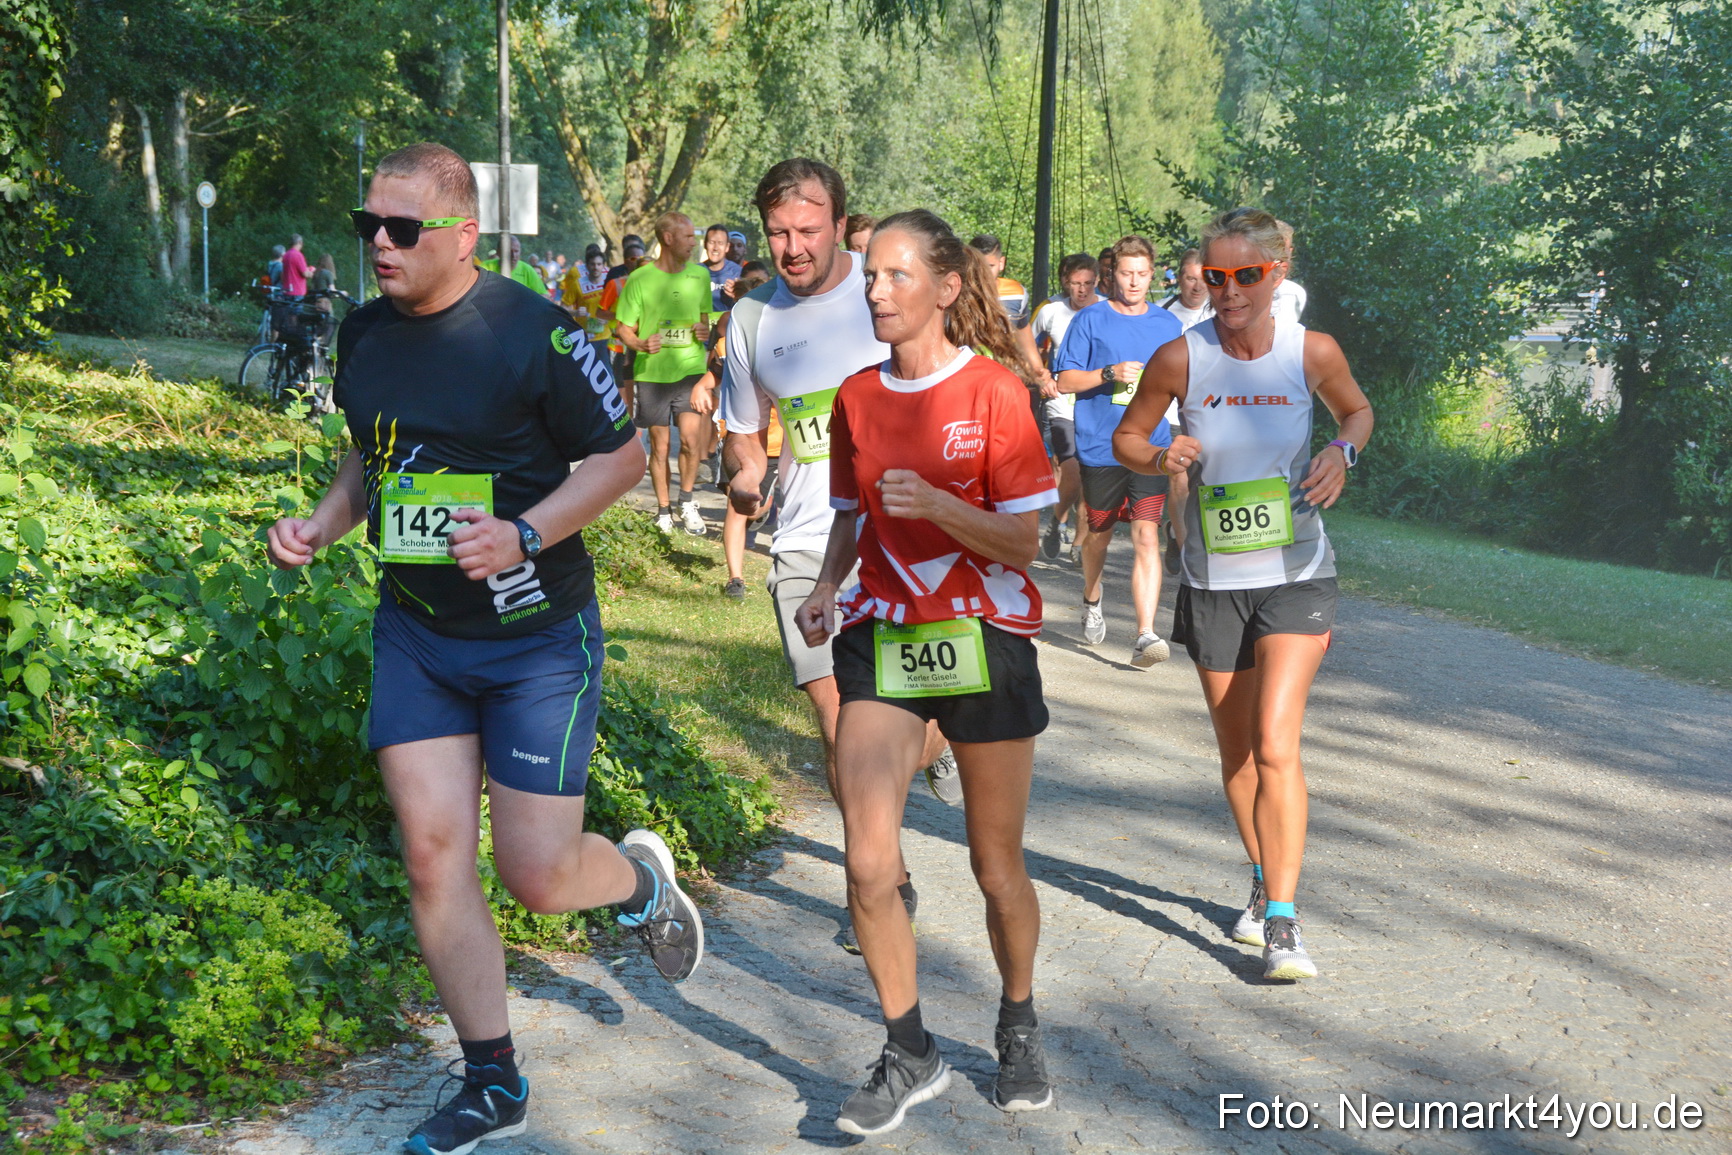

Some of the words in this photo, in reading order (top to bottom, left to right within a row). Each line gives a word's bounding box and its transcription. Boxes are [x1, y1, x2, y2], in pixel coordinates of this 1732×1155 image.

[665, 329, 686, 339] 441
[1125, 382, 1135, 395] 6
[1226, 395, 1294, 406] KLEBL
[942, 420, 981, 440] Town
[977, 424, 984, 435] &
[808, 442, 829, 450] Lerzer
[392, 505, 475, 538] 142
[1218, 504, 1271, 533] 896
[1214, 532, 1252, 542] Kuhlemann
[1253, 528, 1281, 538] Sylvana
[400, 539, 435, 547] Schober
[437, 540, 450, 548] Ma
[500, 601, 551, 625] drinknow.de
[900, 640, 957, 673] 540
[907, 674, 930, 682] Kerler
[931, 673, 958, 682] Gisela
